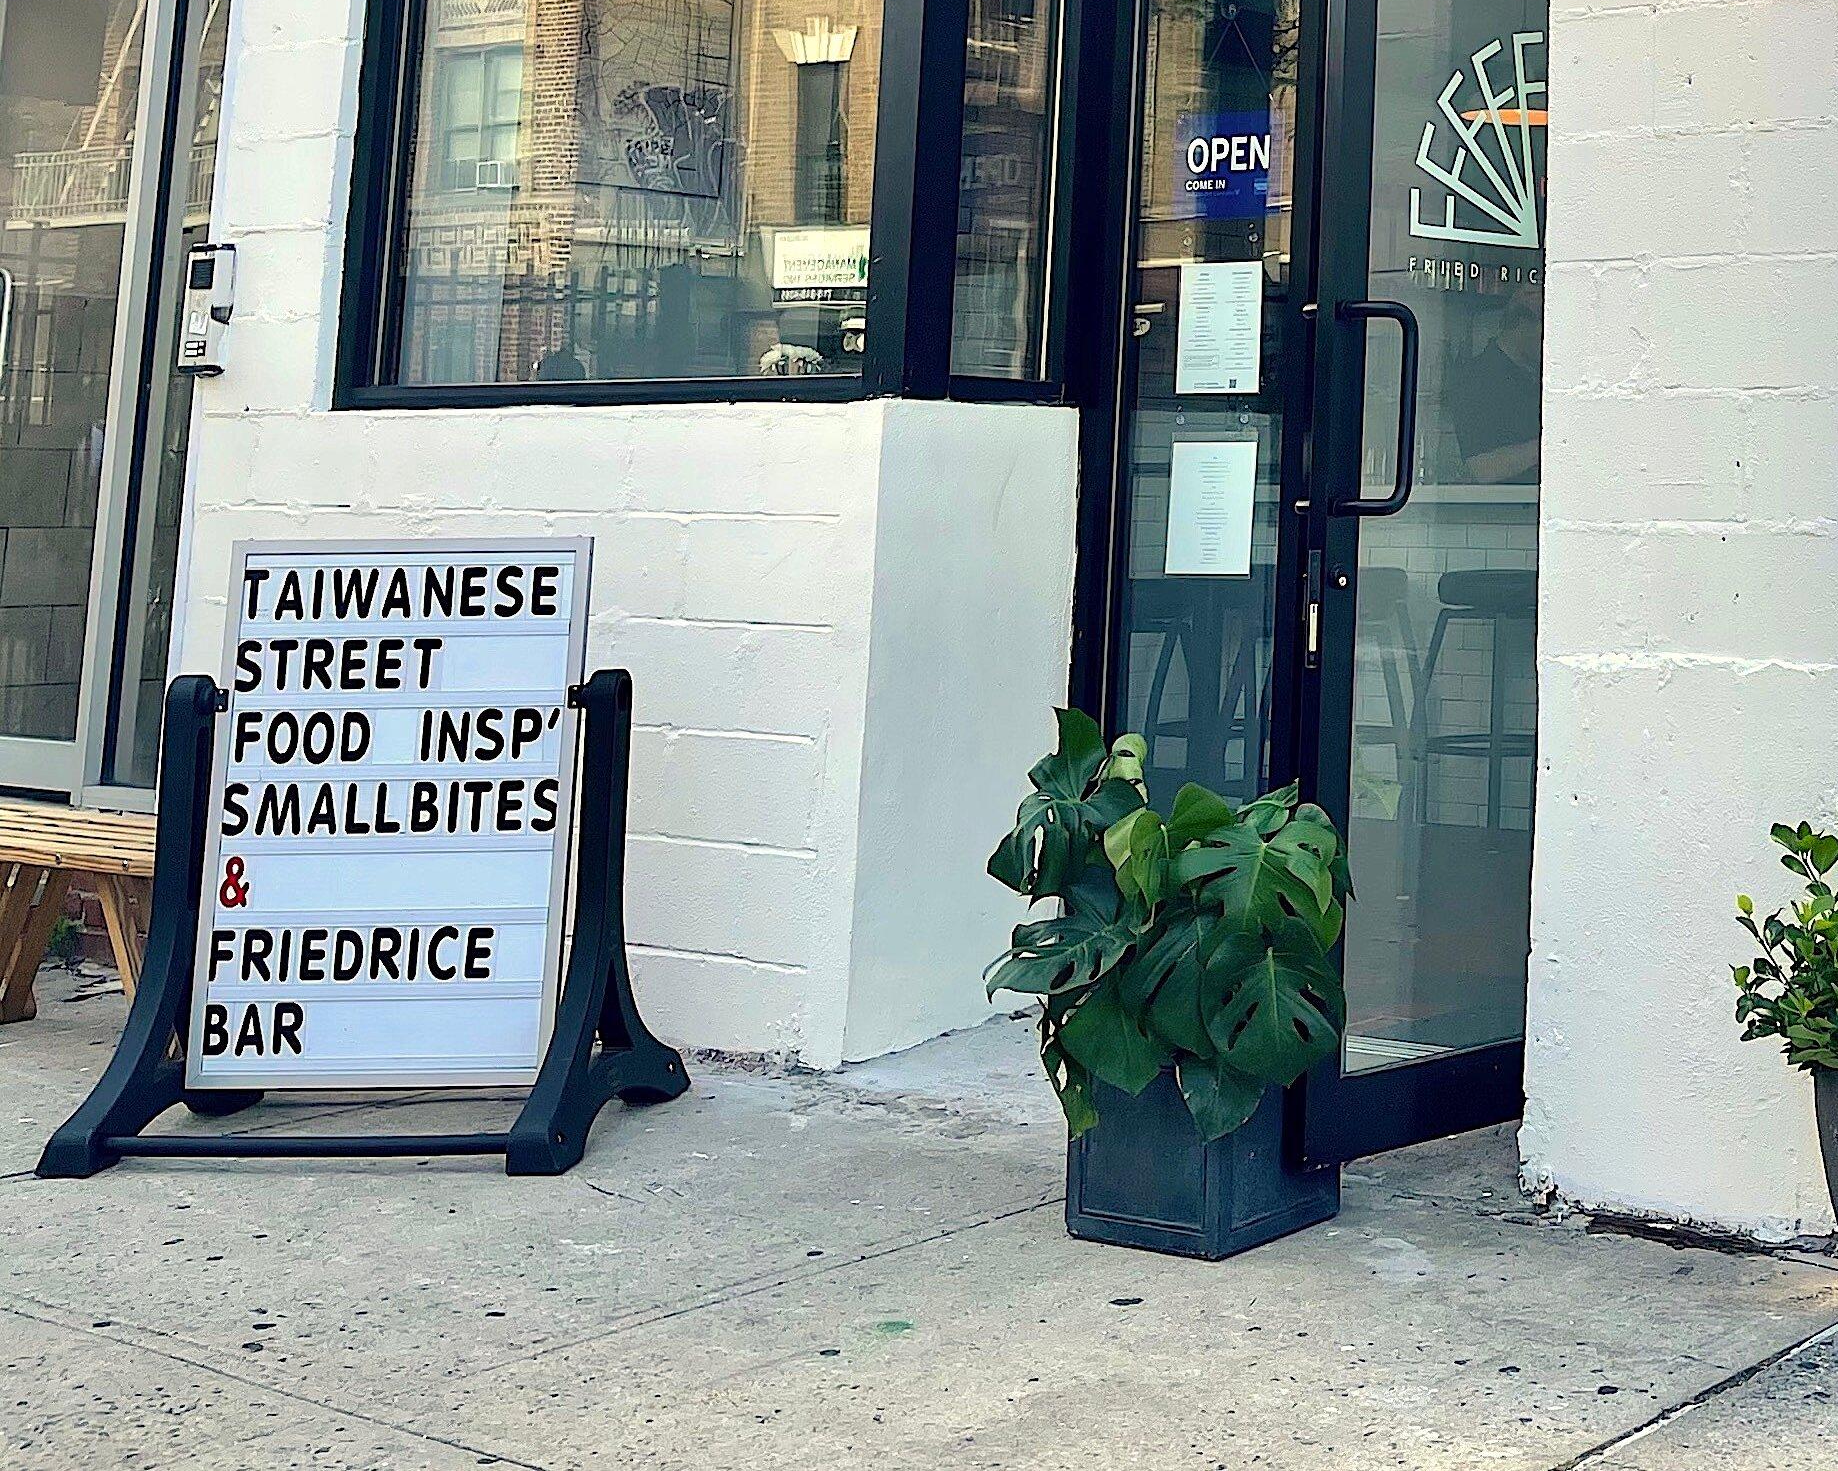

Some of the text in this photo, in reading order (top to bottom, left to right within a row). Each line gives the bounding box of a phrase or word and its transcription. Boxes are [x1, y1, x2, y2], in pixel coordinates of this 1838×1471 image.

[1187, 134, 1271, 173] OPEN
[1185, 179, 1226, 190] COME IN
[1409, 257, 1538, 284] FRIED RIC
[244, 565, 559, 620] TAIWANESE
[234, 638, 443, 692] STREET
[233, 710, 372, 765] FOOD
[219, 855, 250, 909] &
[202, 1001, 305, 1057] BAR
